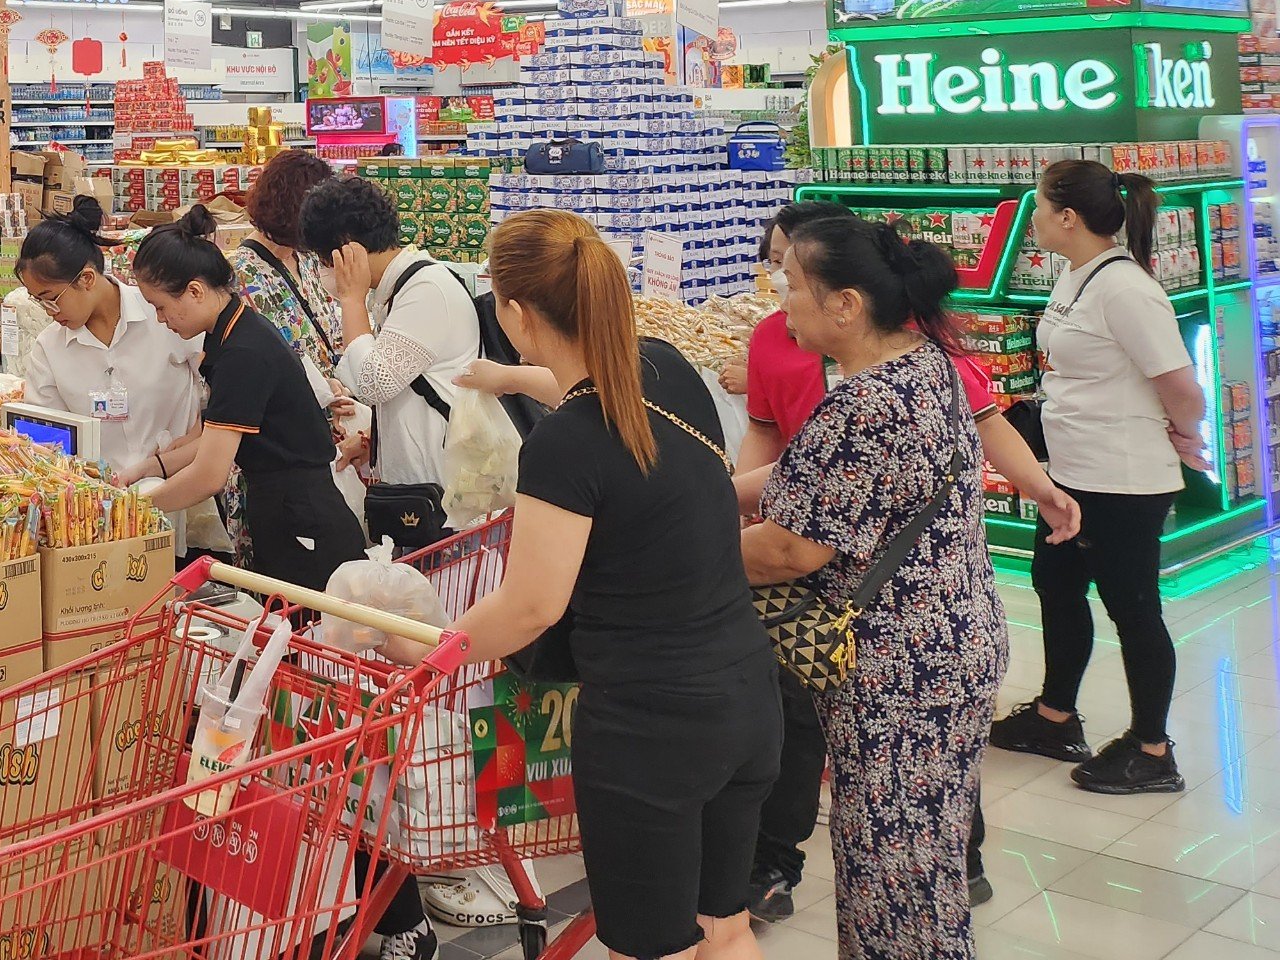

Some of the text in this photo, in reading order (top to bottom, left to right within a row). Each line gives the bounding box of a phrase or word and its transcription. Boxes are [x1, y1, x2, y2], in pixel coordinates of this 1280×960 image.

[226, 65, 240, 73] KHU
[873, 47, 1119, 115] Heine
[1146, 41, 1215, 109] ken
[527, 757, 573, 783] VUI XU
[455, 912, 504, 924] crocs
